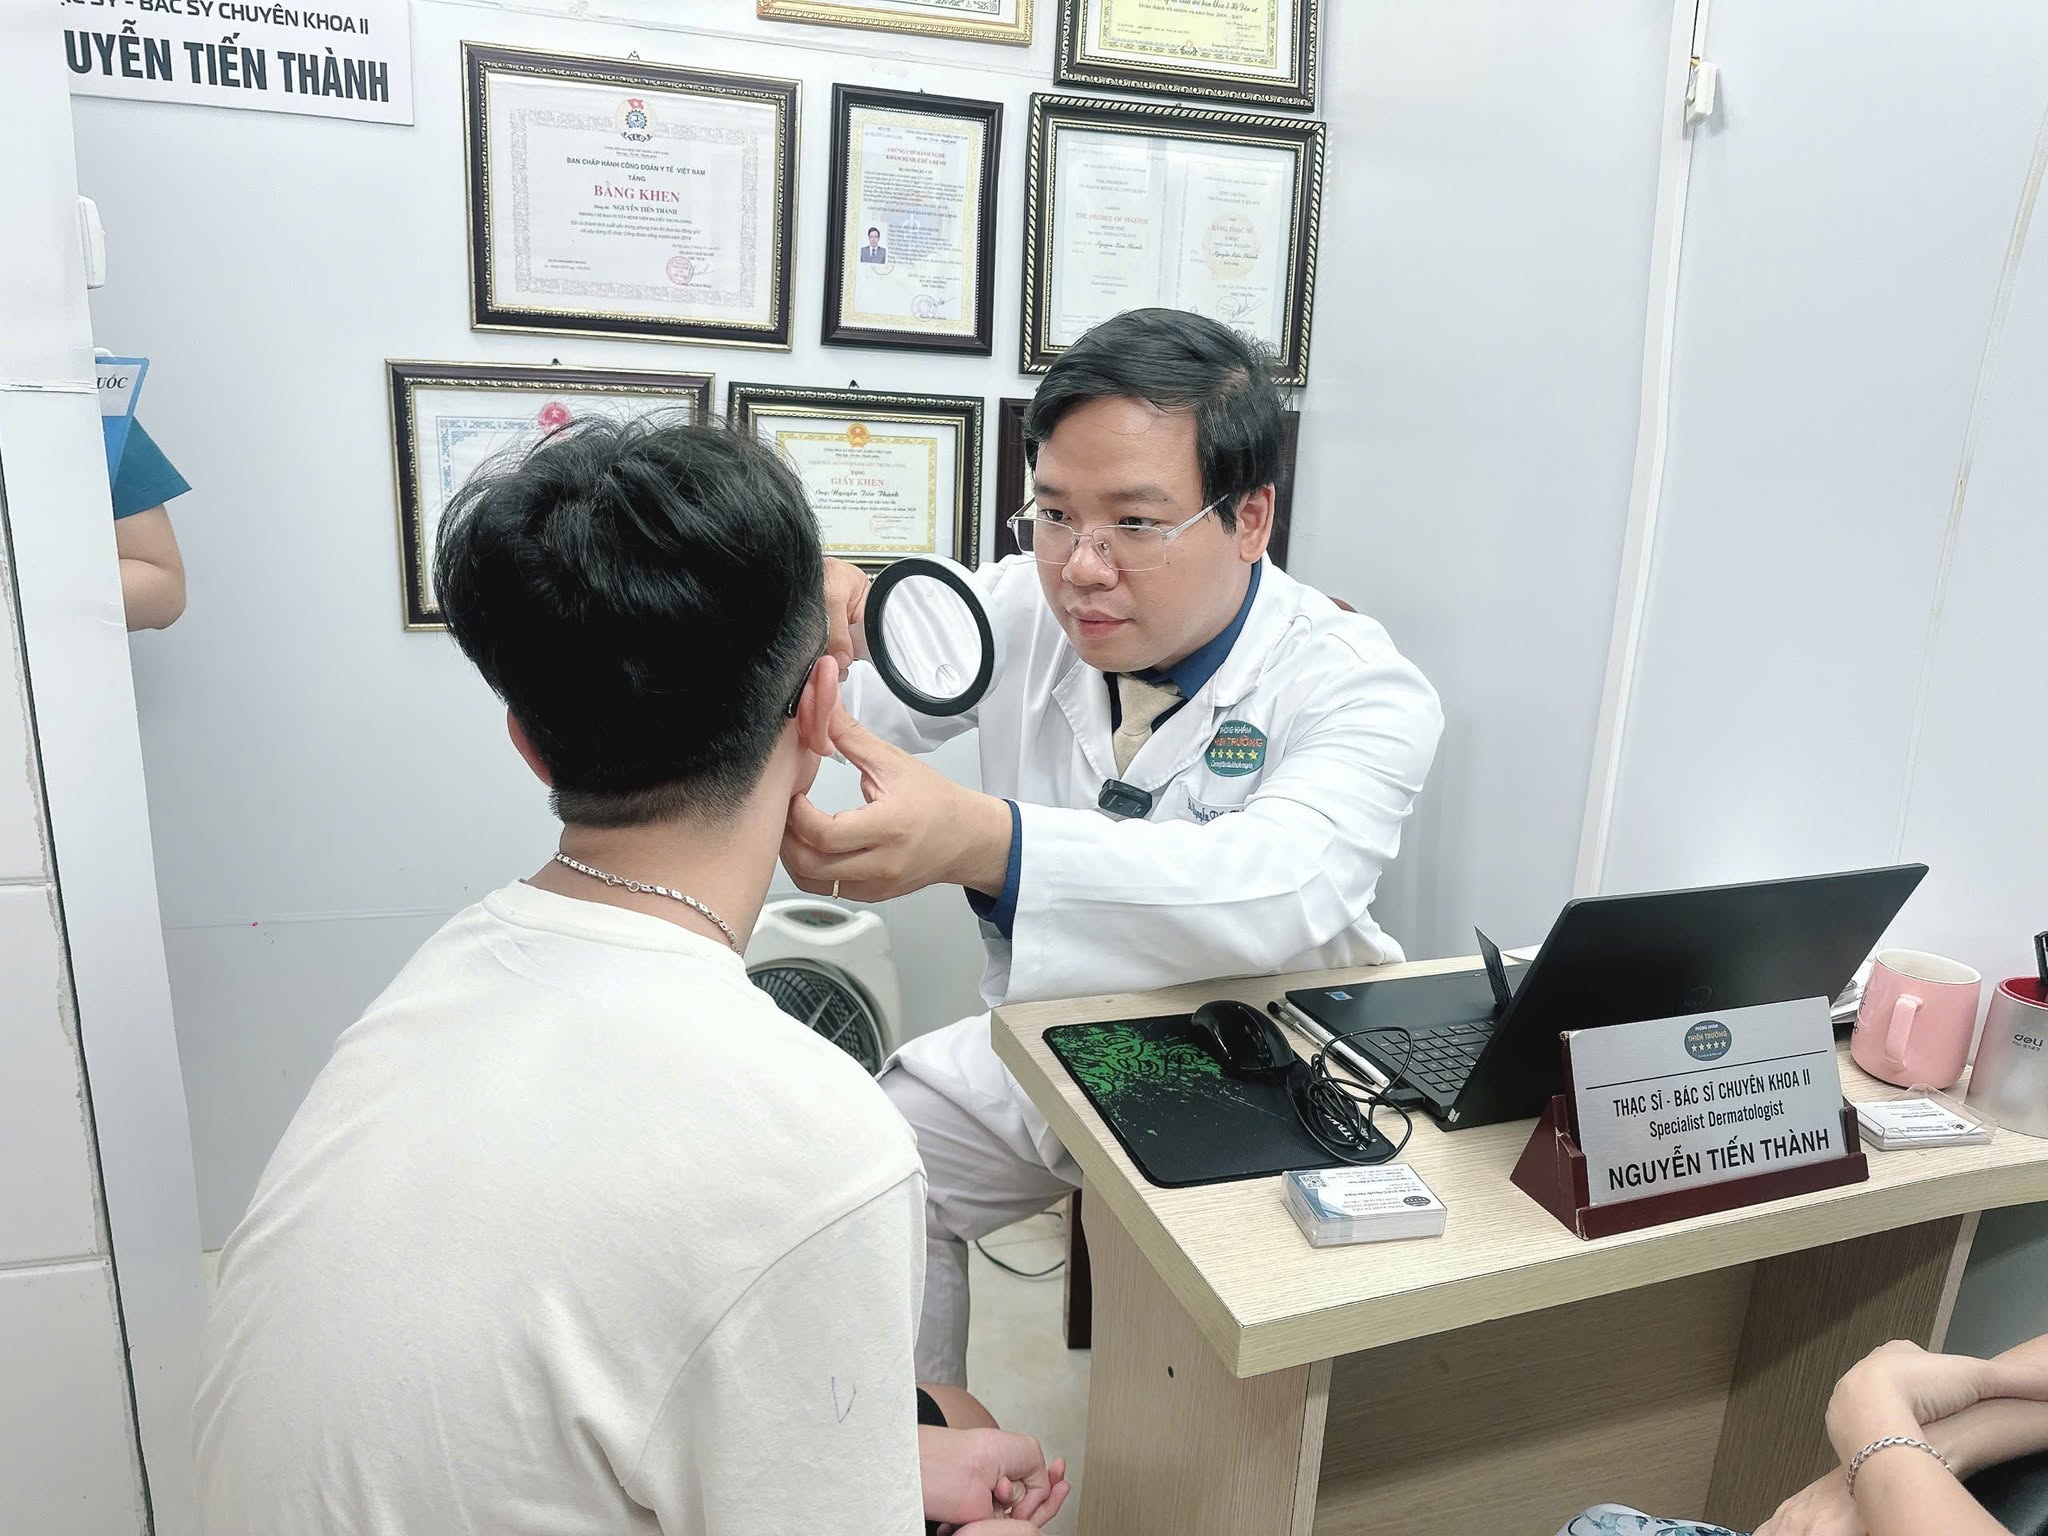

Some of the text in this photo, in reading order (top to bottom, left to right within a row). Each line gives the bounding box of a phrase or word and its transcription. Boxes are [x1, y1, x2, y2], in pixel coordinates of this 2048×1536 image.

[218, 2, 300, 28] CHUYÊN
[303, 11, 356, 34] KHOA
[359, 18, 369, 34] II
[183, 32, 267, 90] TIẾN
[277, 46, 389, 102] THÀNH
[640, 188, 680, 203] KHEN
[857, 478, 884, 488] KHEN
[2014, 1034, 2044, 1047] deli
[1614, 1096, 1647, 1118] THẠC
[1651, 1090, 1664, 1111] SĨ
[1675, 1086, 1700, 1107] BÁC
[1703, 1081, 1716, 1102] SĨ
[1718, 1074, 1765, 1100] CHUYÊN
[1768, 1070, 1800, 1092] KHOA
[1804, 1068, 1811, 1086] II
[1650, 1100, 1784, 1140] Specialist Dermatologist
[1608, 1128, 1830, 1190] NGUYỄN TIẾN THÀNH
